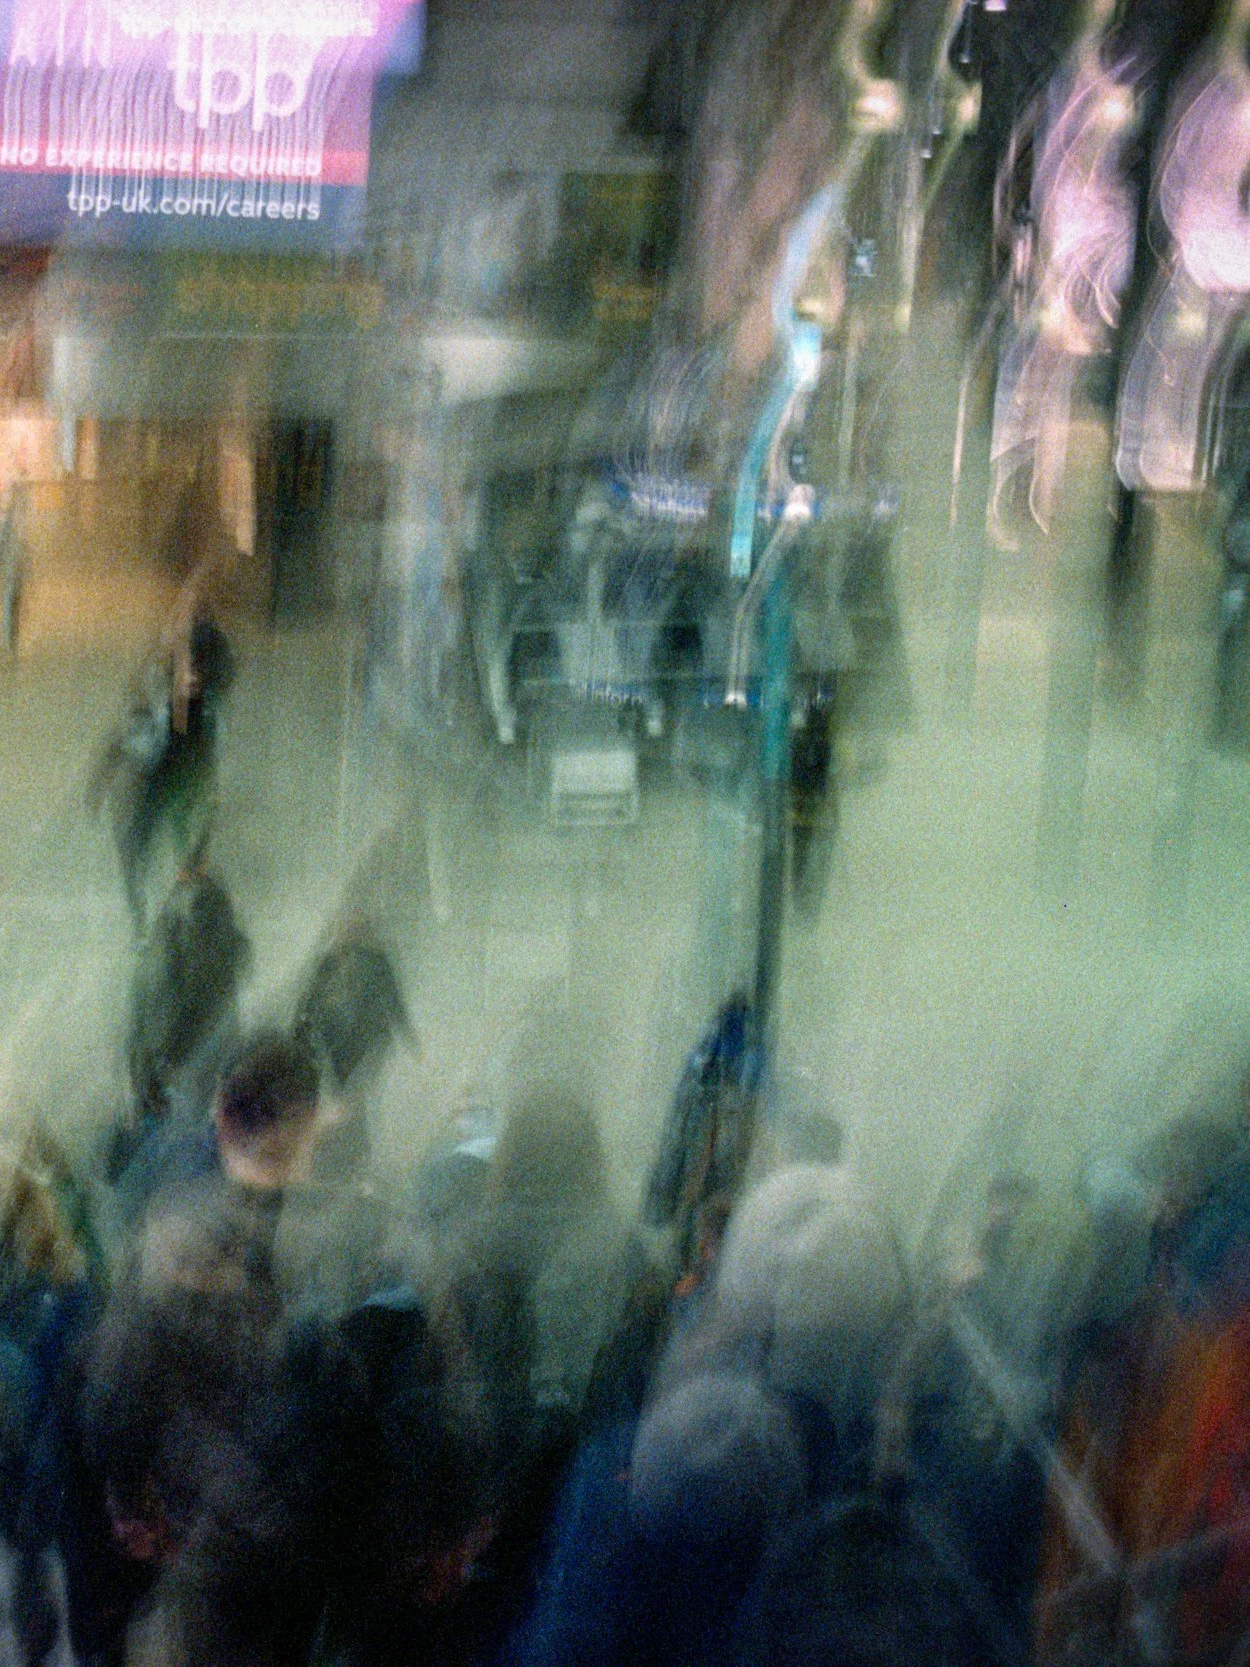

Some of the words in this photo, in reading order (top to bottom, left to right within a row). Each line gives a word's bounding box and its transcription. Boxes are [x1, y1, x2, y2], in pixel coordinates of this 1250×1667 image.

[0, 144, 39, 166] NO
[45, 146, 192, 172] EXPERIENCE
[199, 151, 322, 177] REQUIRED
[67, 190, 321, 221] tpp-uk.com/careers
